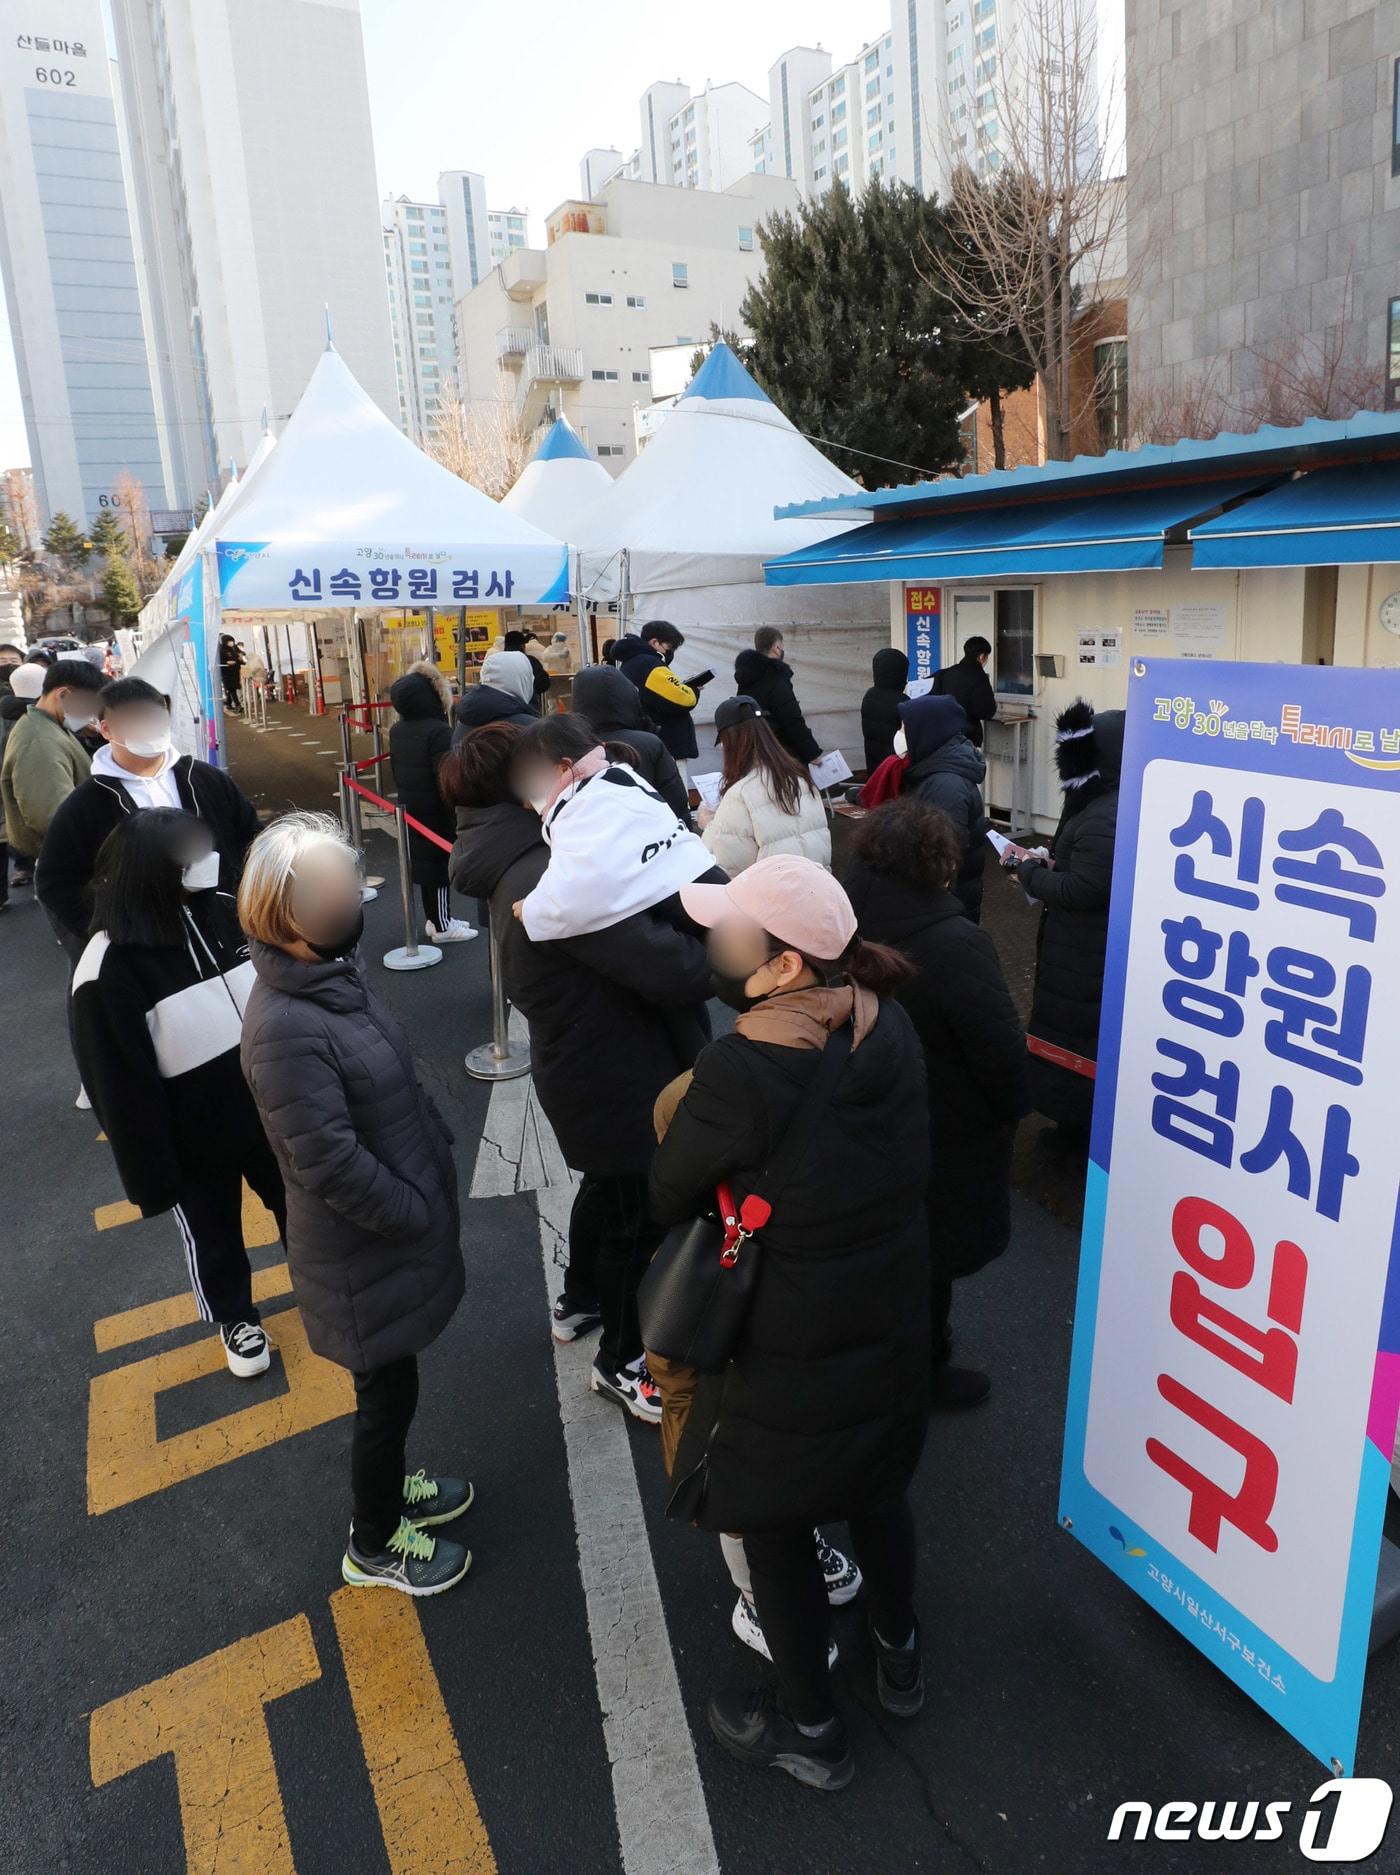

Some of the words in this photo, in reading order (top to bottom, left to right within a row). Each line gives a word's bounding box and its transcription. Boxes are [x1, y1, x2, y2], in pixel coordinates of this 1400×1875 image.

[17, 35, 87, 58] 산들마을
[35, 66, 77, 87] 602
[289, 568, 438, 600] 신속항원
[452, 569, 515, 599] 검사
[911, 591, 936, 610] 접수
[1169, 790, 1387, 943] 신속
[1161, 915, 1373, 1087] 항원
[1151, 1038, 1361, 1223] 검사
[1145, 1195, 1309, 1555] 입구
